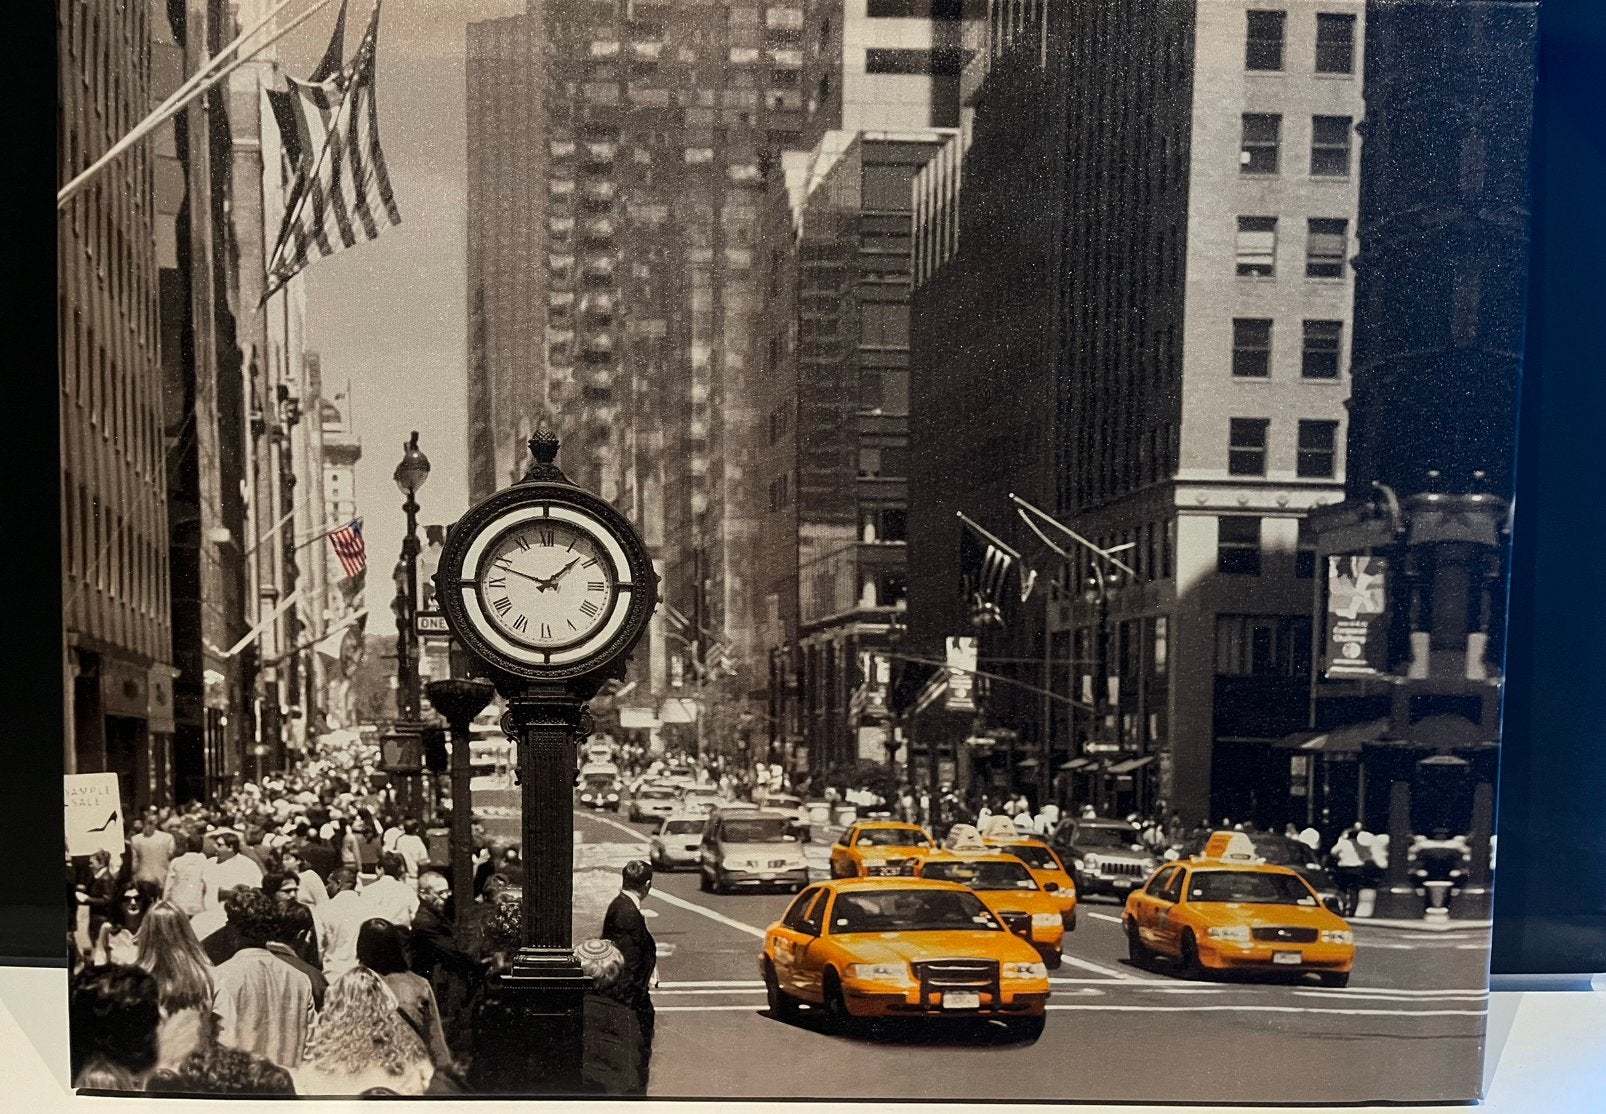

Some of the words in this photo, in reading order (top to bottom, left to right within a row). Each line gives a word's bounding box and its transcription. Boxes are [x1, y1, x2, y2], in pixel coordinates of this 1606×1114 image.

[539, 530, 554, 547] XII
[566, 539, 577, 553] I
[581, 557, 598, 569] II
[587, 581, 604, 591] III
[493, 597, 512, 617] VIII
[579, 600, 599, 618] IIII
[421, 618, 447, 629] ONE
